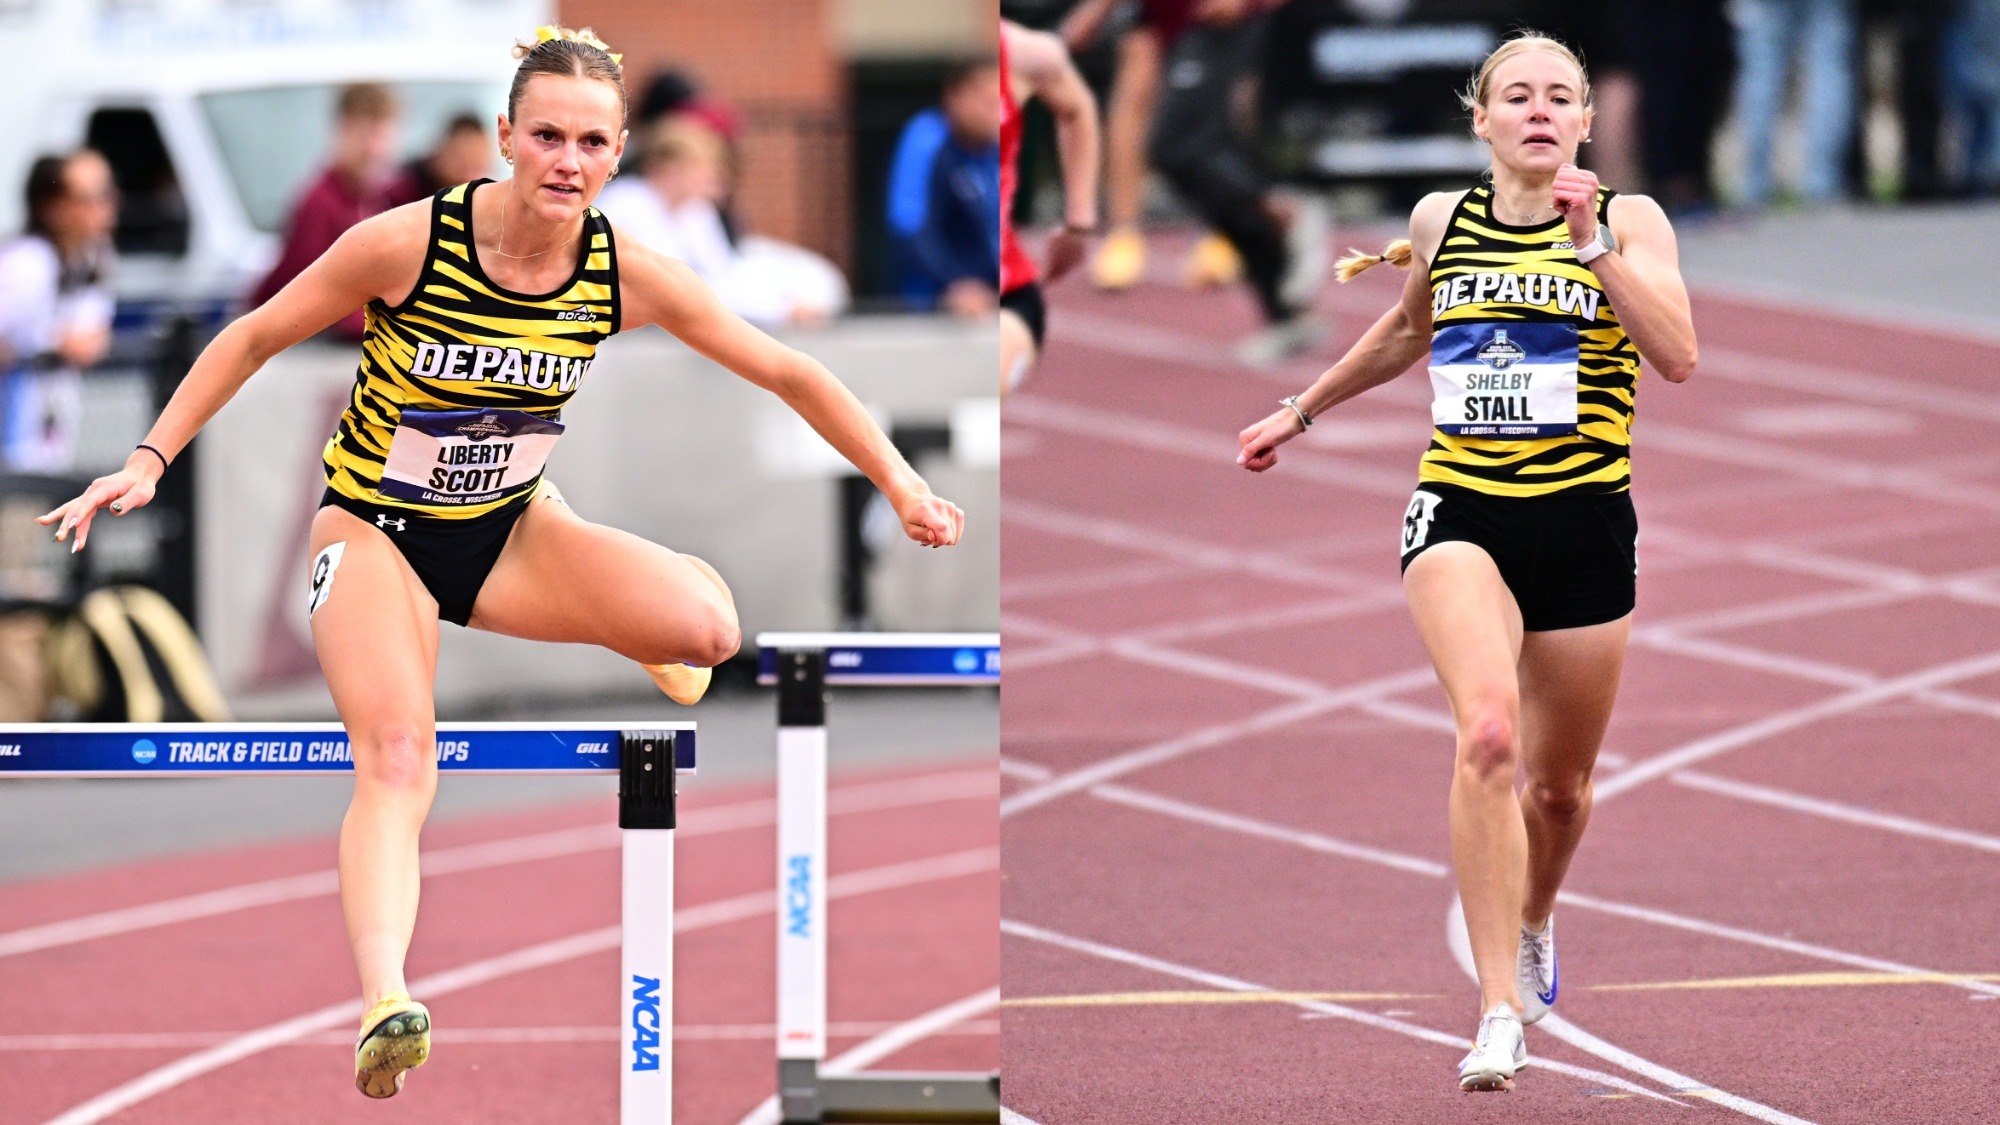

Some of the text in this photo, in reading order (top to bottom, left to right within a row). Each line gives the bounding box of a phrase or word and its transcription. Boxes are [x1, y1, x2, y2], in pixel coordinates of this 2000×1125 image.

[1434, 271, 1600, 322] DEPAUW
[410, 341, 591, 392] DEPAUW
[1466, 373, 1532, 390] SHELBY
[1464, 396, 1533, 421] STALL
[1460, 427, 1538, 435] LA CROSSE, WISCONSIN
[437, 443, 514, 465] LIBERTY
[428, 466, 509, 493] SCOTT
[422, 491, 503, 504] LA CROSSE, WISCONSIN
[1405, 498, 1424, 548] 8
[311, 553, 330, 614] 9
[169, 742, 231, 763] TRACK
[232, 742, 248, 763] &
[251, 742, 303, 763] FIELD
[576, 743, 609, 754] GILL
[788, 855, 811, 938] NCAA
[632, 974, 660, 1072] NCAA
